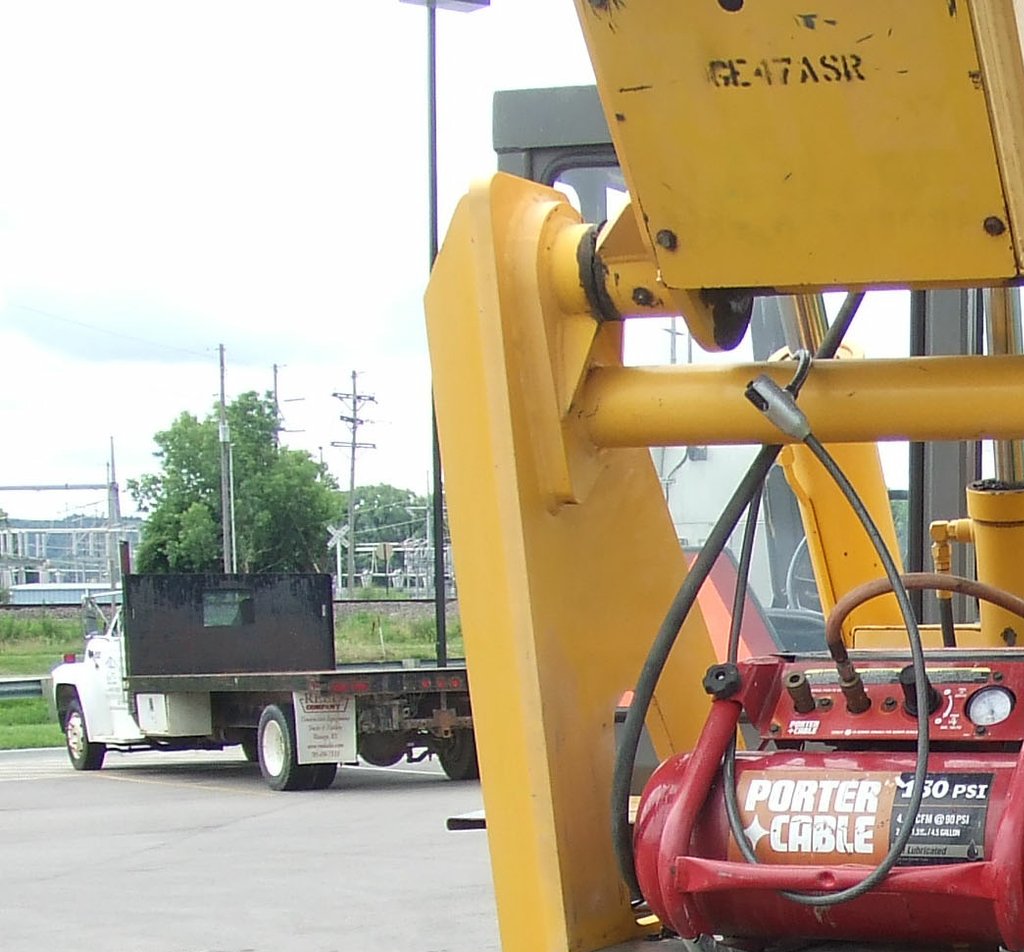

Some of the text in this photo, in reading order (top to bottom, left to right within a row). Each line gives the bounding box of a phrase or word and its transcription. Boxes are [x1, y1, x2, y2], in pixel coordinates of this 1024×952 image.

[706, 54, 865, 88] GE47ASR
[745, 780, 882, 812] PORTER
[952, 784, 988, 799] PSI
[956, 814, 970, 825] PSI
[770, 814, 876, 853] CABLE
[907, 846, 947, 855] Lubricated
